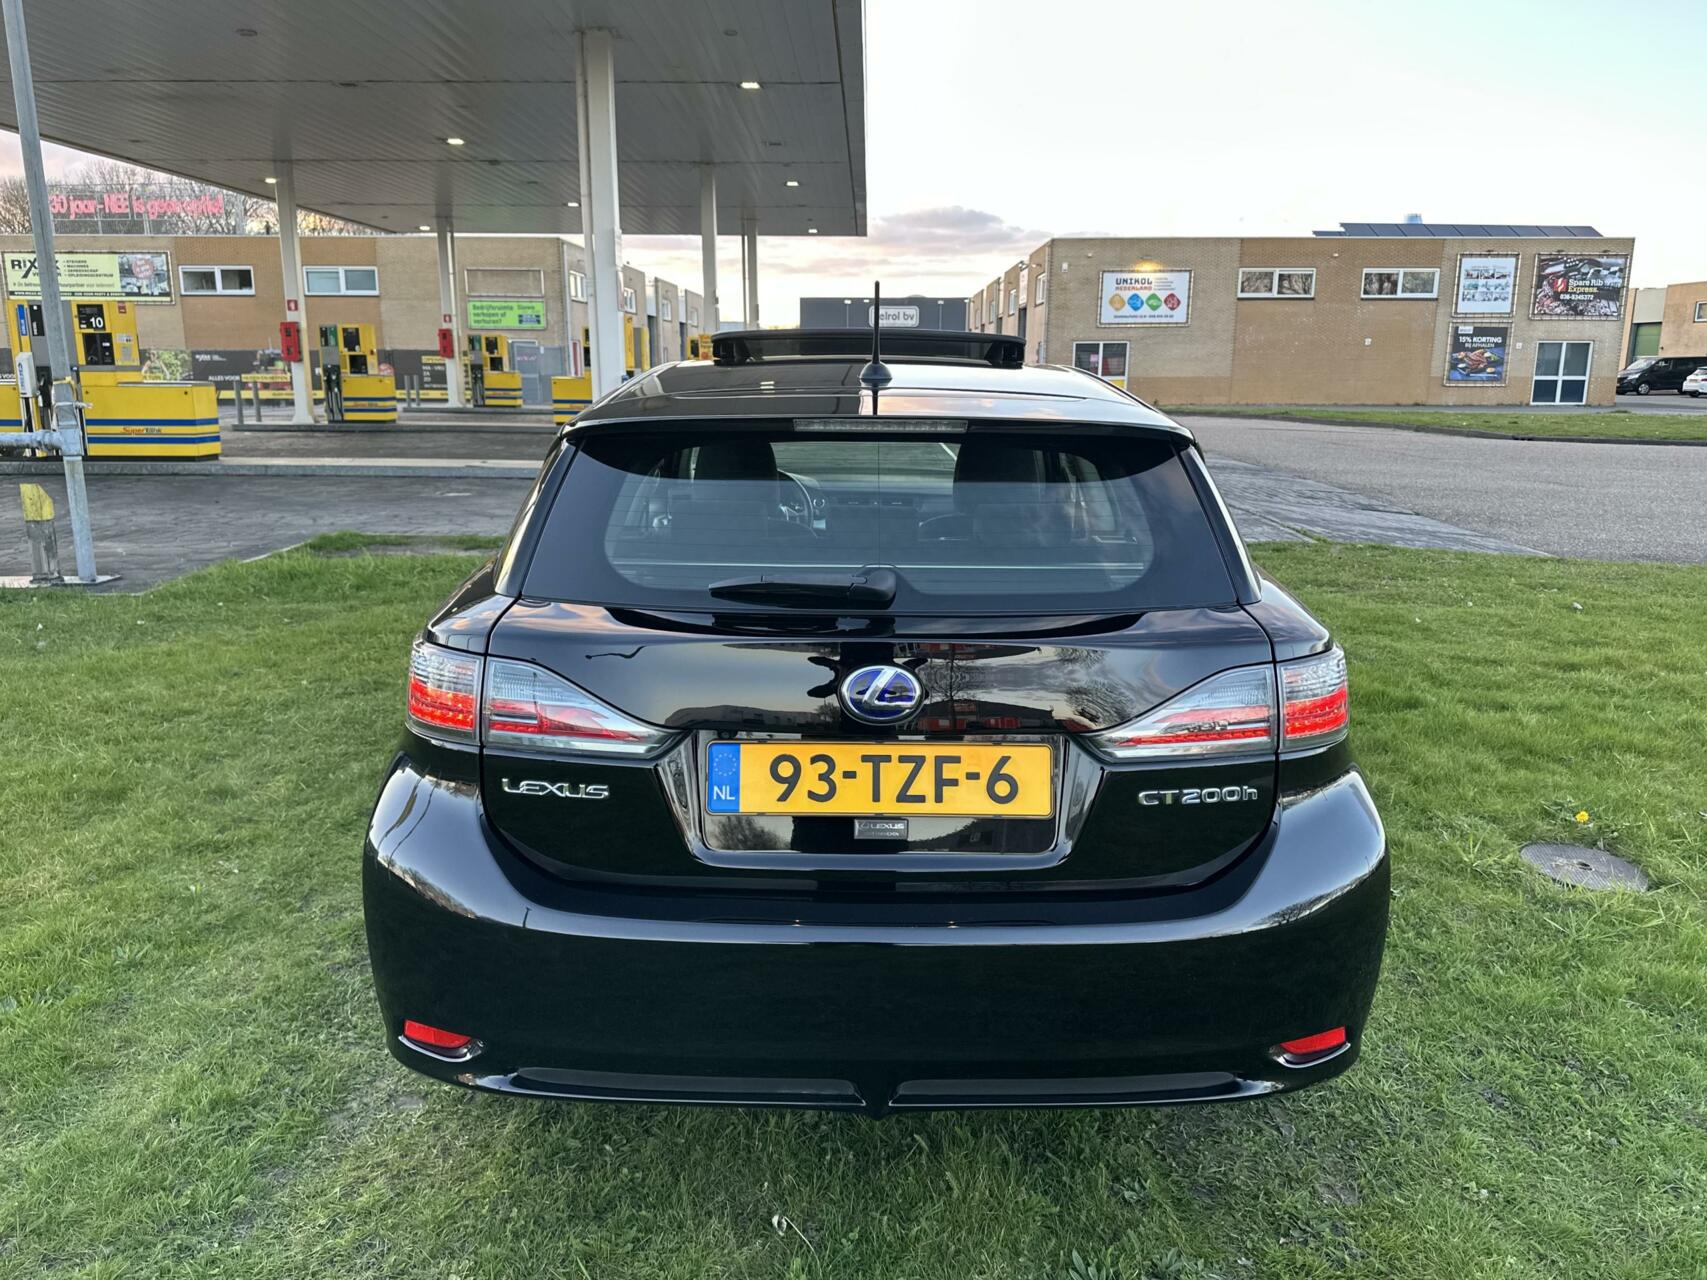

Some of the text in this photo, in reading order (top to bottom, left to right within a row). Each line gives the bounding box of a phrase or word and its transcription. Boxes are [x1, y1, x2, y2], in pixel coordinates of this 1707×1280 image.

[1115, 277, 1153, 285] UNIKOL
[1568, 278, 1604, 287] Spare Rib
[875, 311, 915, 321] elrol bv
[90, 317, 104, 328] 10
[769, 753, 1019, 805] 93-TZF-6
[501, 778, 609, 799] LEXUS
[713, 787, 736, 800] NL
